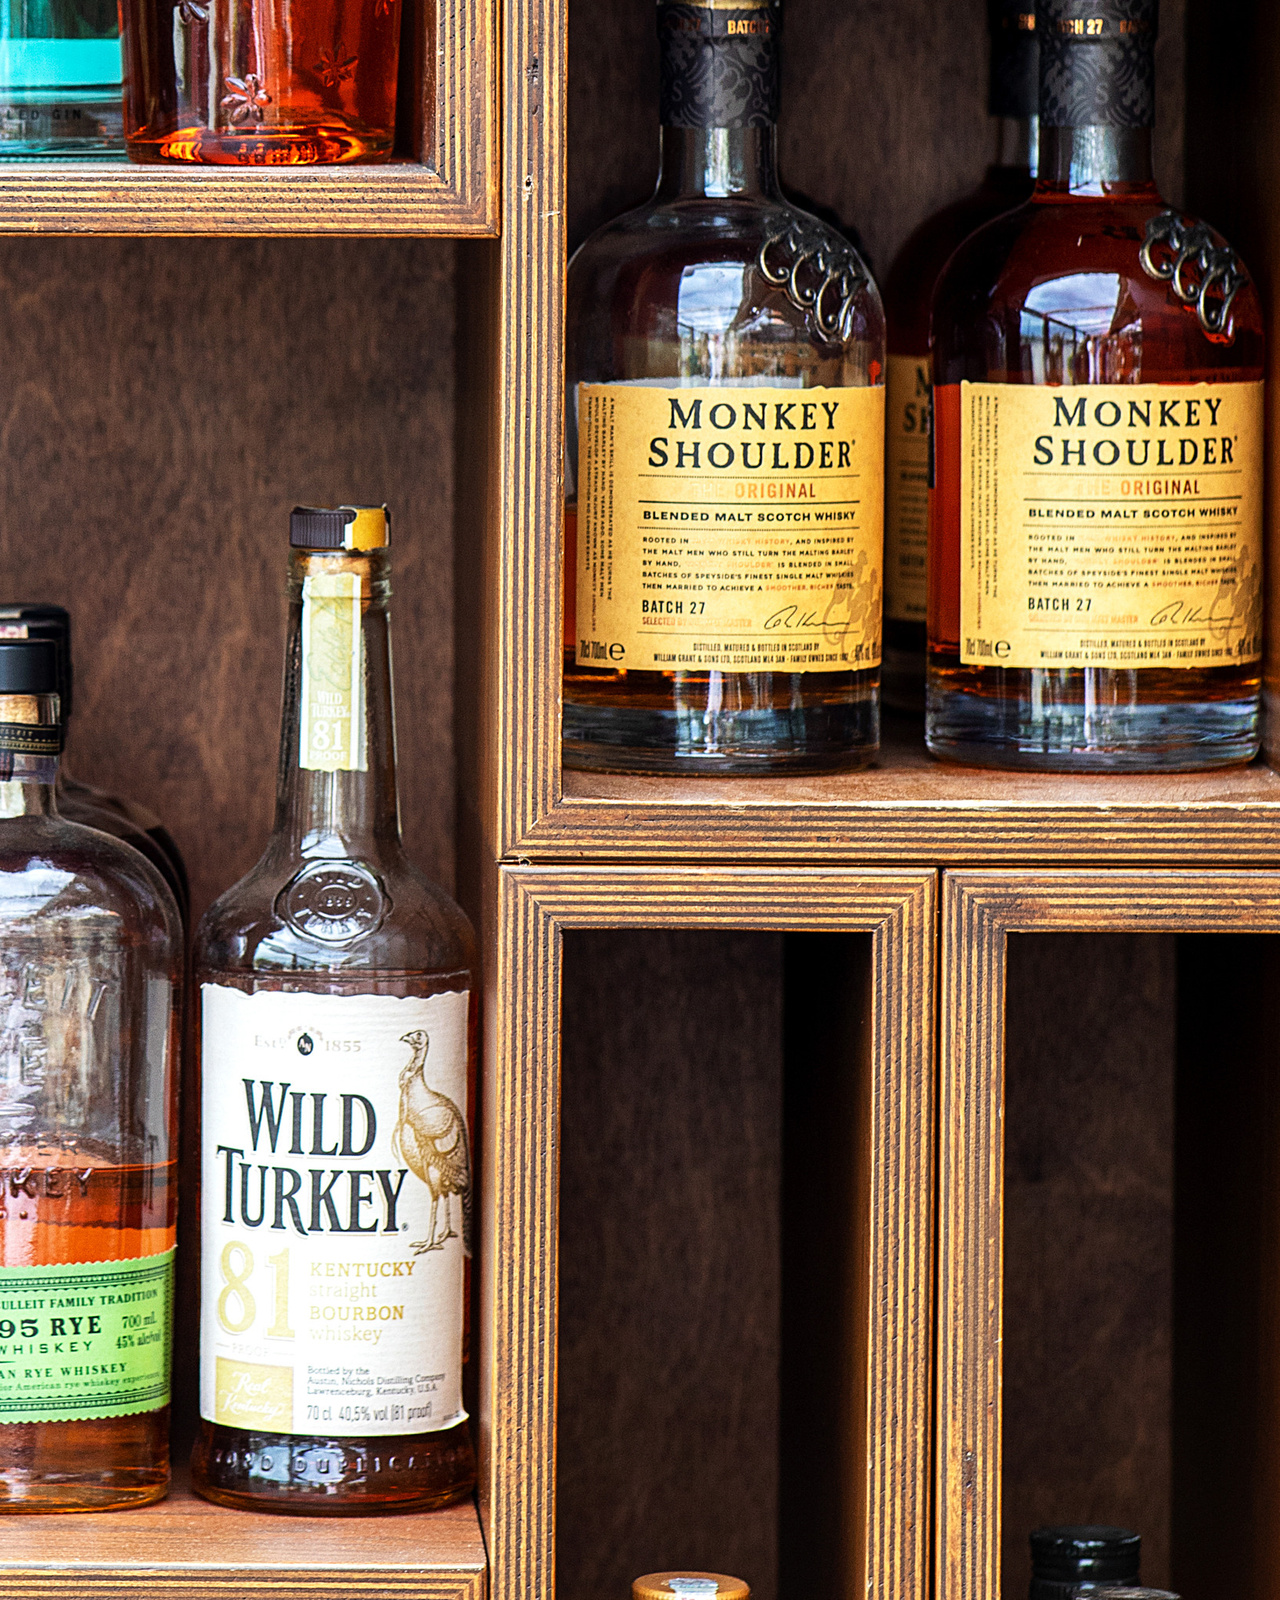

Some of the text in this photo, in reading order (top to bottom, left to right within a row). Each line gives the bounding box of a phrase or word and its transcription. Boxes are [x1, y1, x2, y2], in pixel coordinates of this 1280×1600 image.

[668, 397, 840, 431] MONKEY
[1053, 396, 1222, 428] MONKEY
[648, 436, 852, 470] SHOULDER
[1033, 435, 1234, 466] SHOULDER
[734, 481, 817, 499] ORIGINAL
[1121, 479, 1201, 496] ORIGINAL
[643, 510, 856, 523] BLENDED MALT SCOTCH WHISKY
[1028, 506, 1238, 520] BLENDED MALT SCOTCH WHISKY
[642, 599, 705, 615] BATCH 27
[1028, 597, 1092, 612] BATCH 27
[242, 1077, 377, 1159] WILD
[217, 1145, 409, 1237] TURKEY
[310, 1260, 417, 1278] KENTUCKY
[218, 1240, 295, 1340] 81
[309, 1281, 377, 1300] straight
[310, 1304, 405, 1323] BOURBON
[50, 1315, 103, 1337] RYE
[309, 1324, 383, 1345] whiskey
[24, 1366, 53, 1379] RYE
[60, 1362, 129, 1377] WHISKEY
